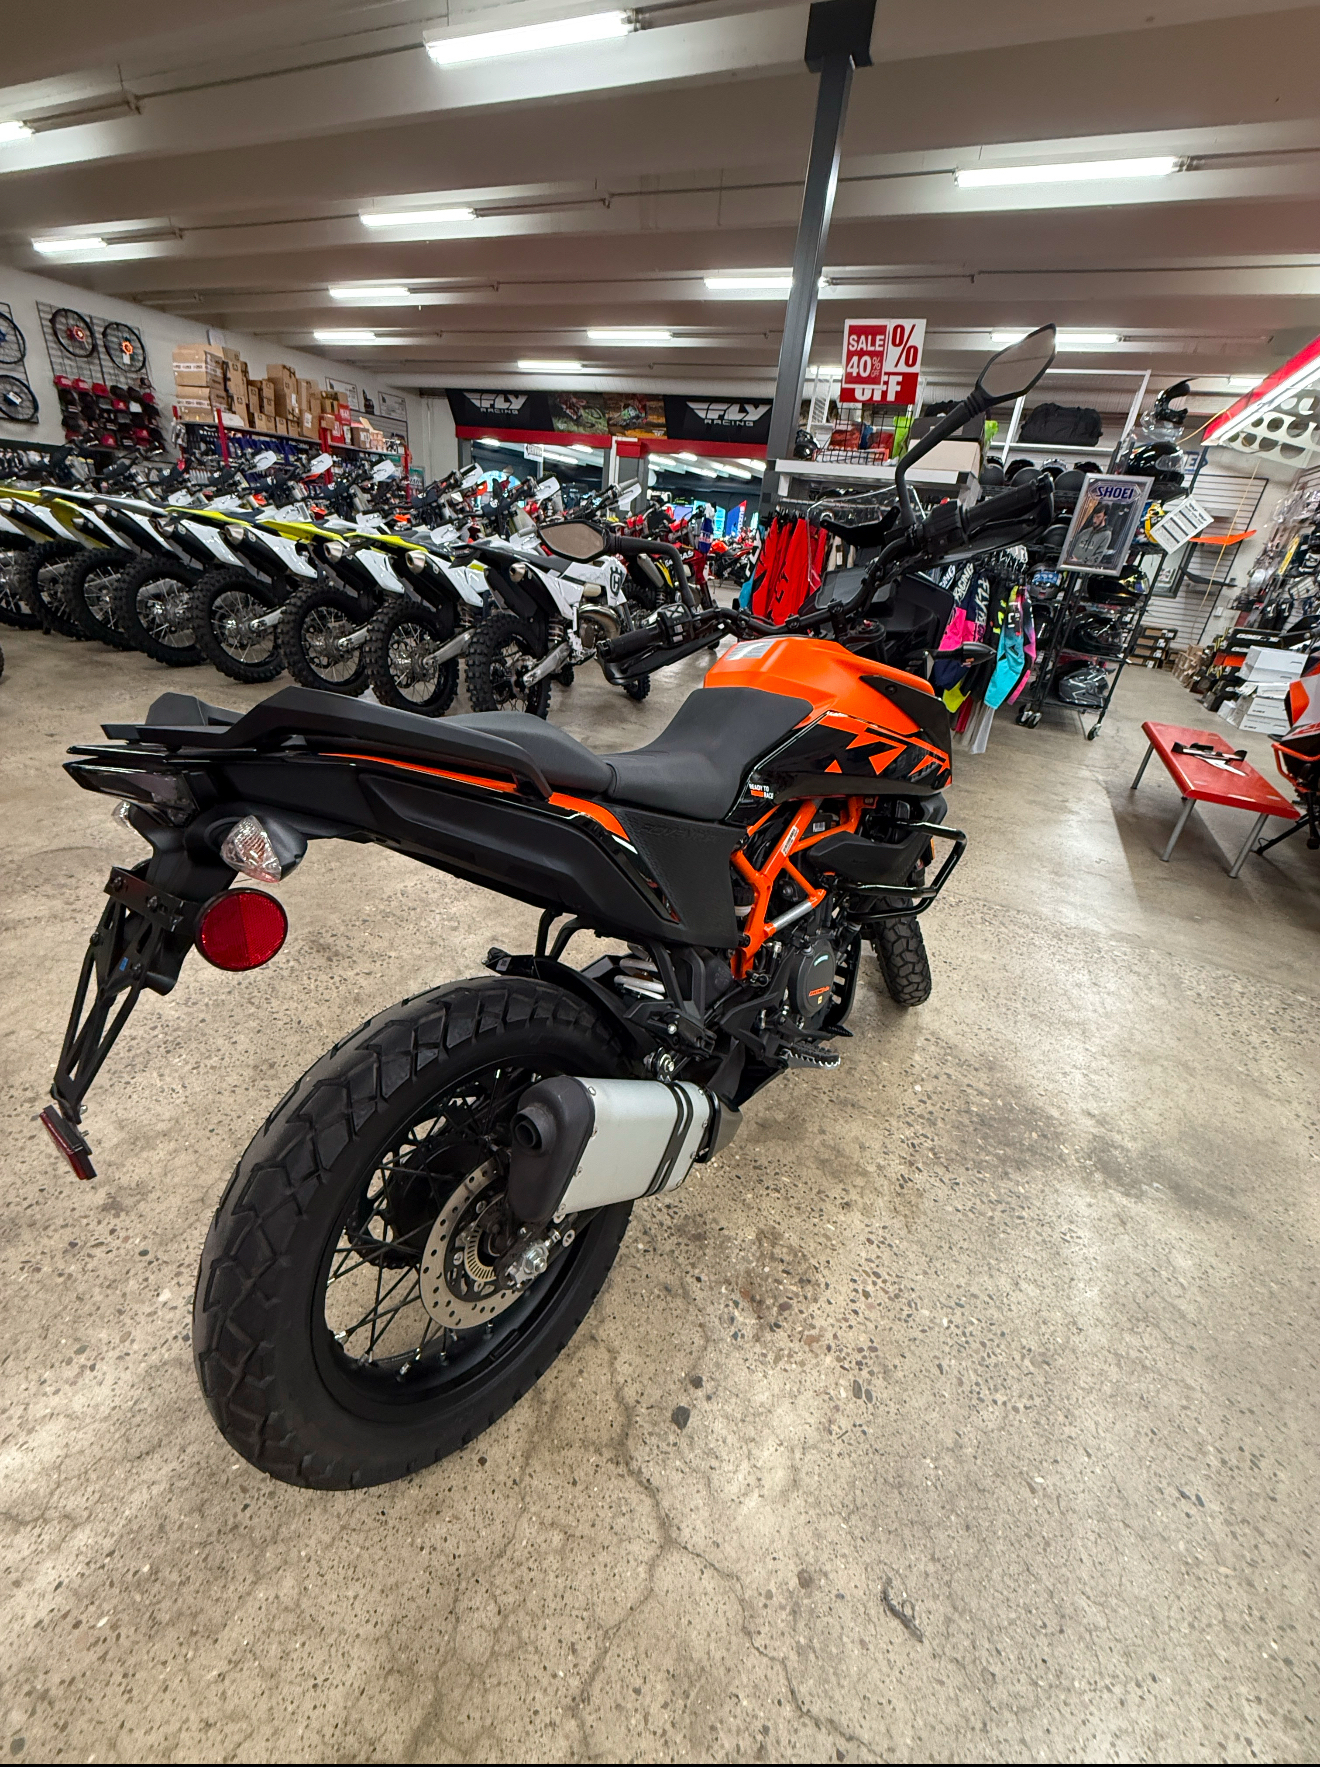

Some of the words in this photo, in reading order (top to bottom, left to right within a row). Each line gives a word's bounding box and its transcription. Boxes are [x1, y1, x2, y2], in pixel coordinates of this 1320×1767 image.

[848, 334, 884, 351] SALE
[463, 392, 528, 409] FLY
[686, 402, 772, 421] FLY
[704, 419, 754, 427] RACING
[1095, 486, 1135, 500] SHOEI
